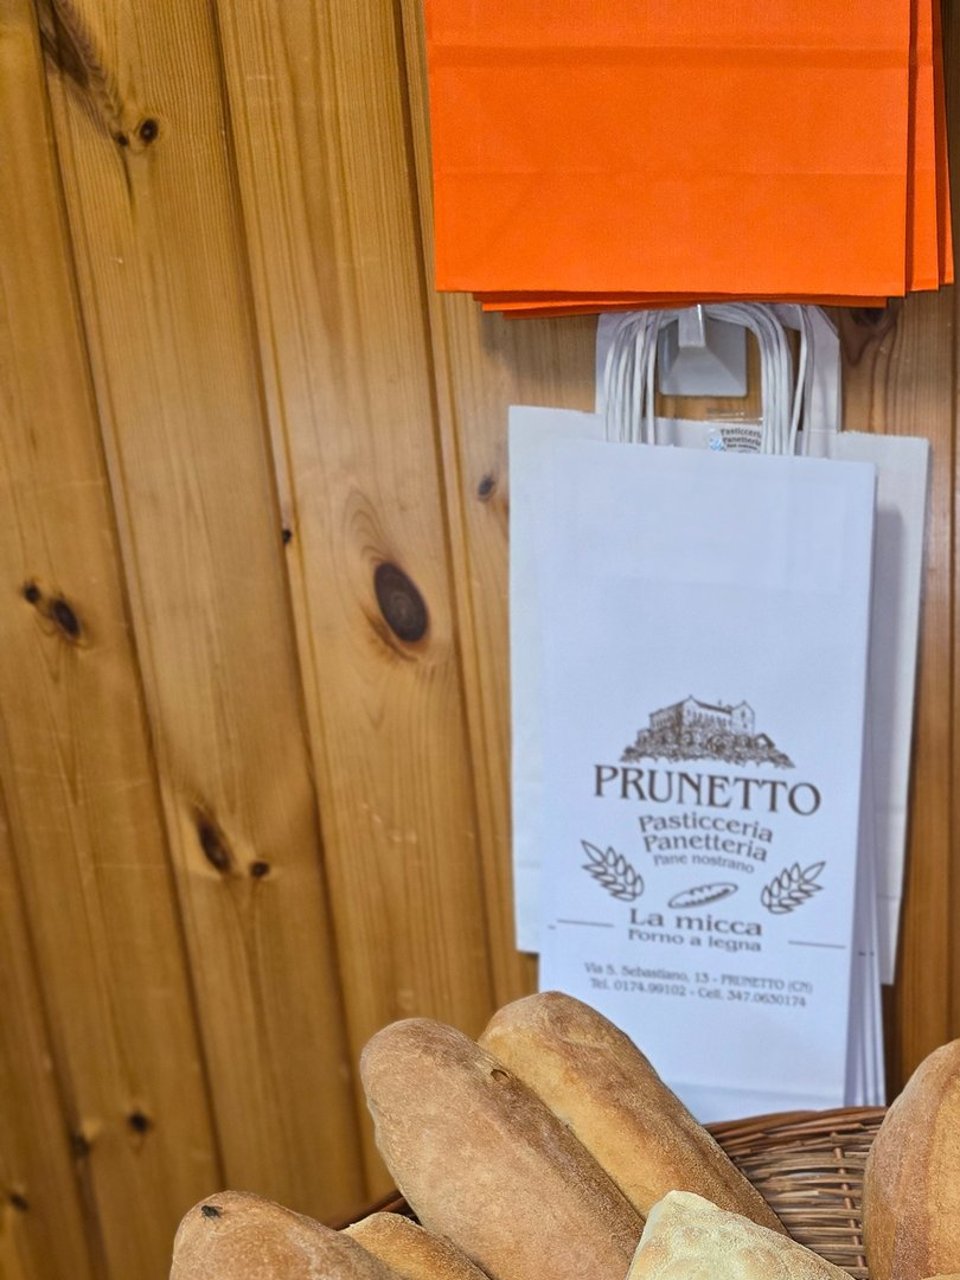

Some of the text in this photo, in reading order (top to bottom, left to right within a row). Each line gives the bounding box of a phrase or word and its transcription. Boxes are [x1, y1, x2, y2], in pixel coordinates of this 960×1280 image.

[594, 764, 822, 816] PRUNETTO
[638, 812, 774, 843] Pasticceria
[643, 834, 768, 862] Panetteria
[653, 854, 755, 874] Pane nostrano
[629, 908, 763, 936] La micca
[628, 929, 762, 952] Forno a legna
[584, 962, 603, 975] Via
[721, 974, 785, 990] PRUNETTO
